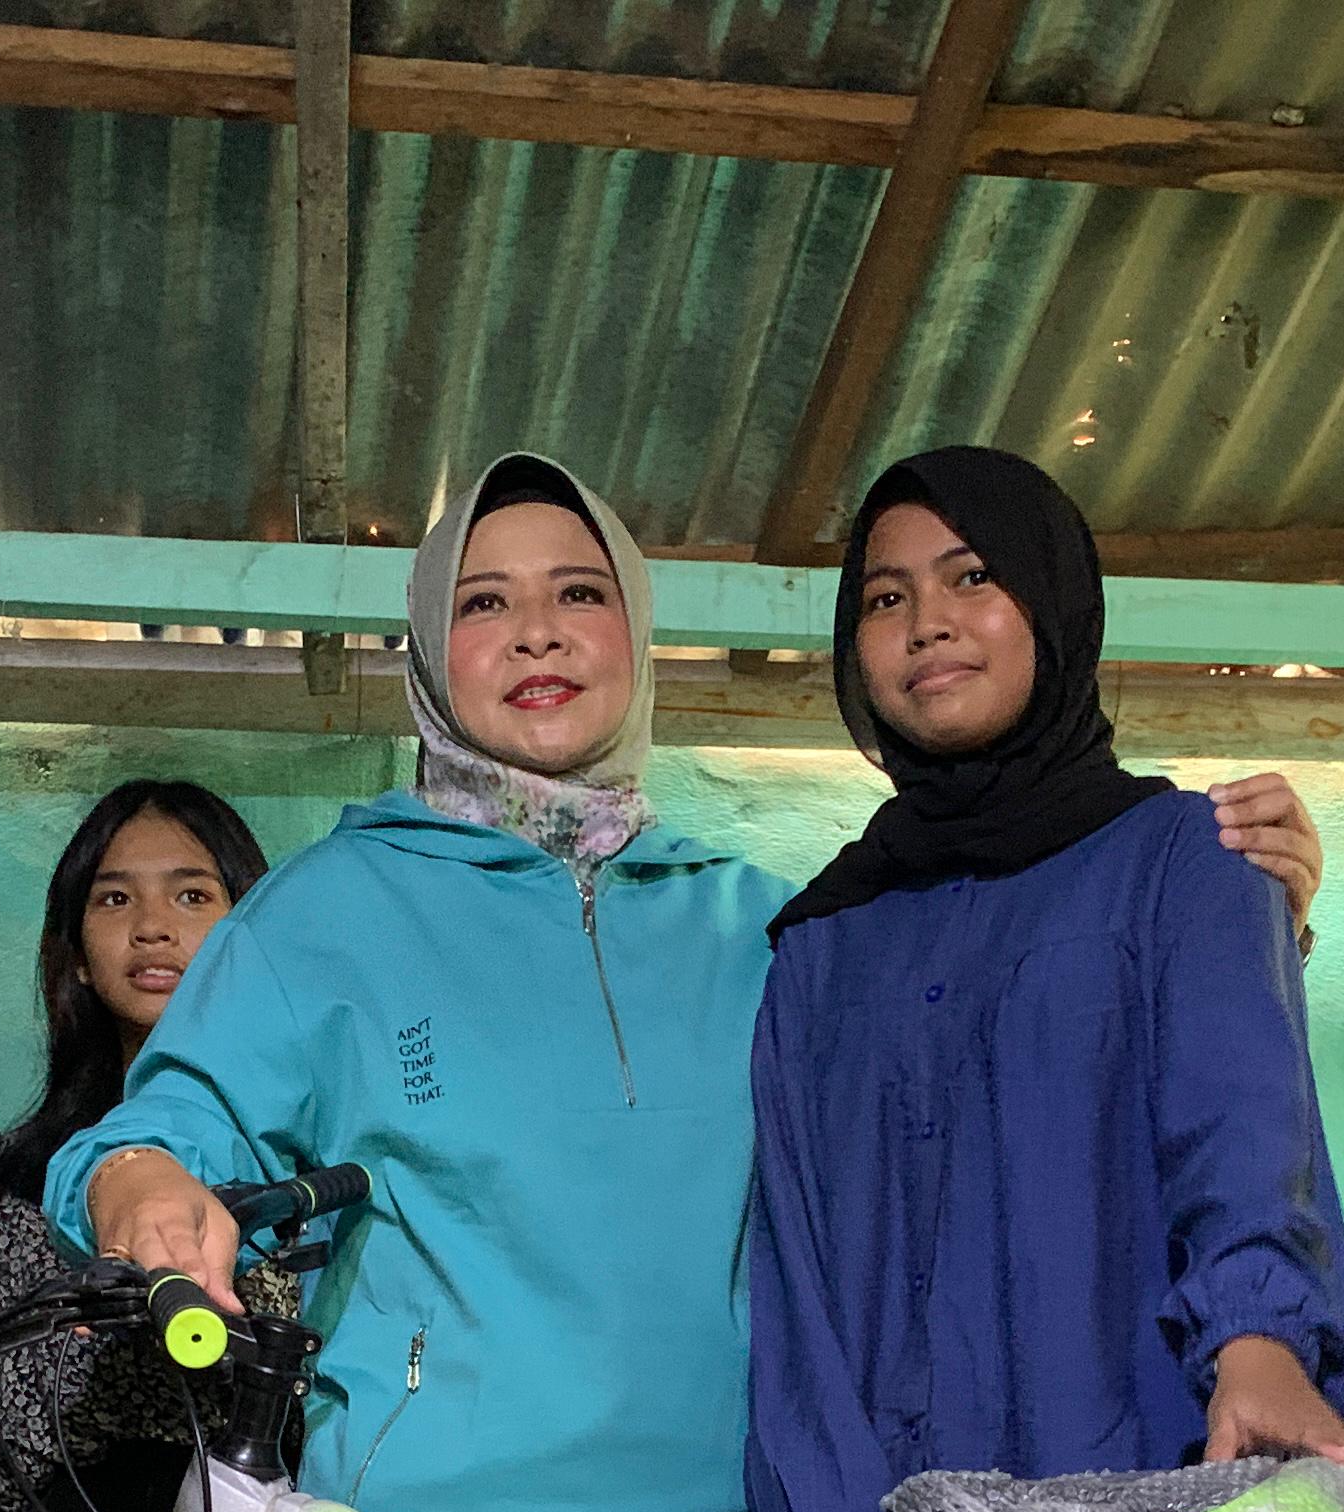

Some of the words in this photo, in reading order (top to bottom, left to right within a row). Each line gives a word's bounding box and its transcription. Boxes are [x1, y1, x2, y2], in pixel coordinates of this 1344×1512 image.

[398, 1036, 431, 1056] GOT
[400, 1052, 436, 1073] TIME
[403, 1071, 433, 1088] FOR
[404, 1084, 445, 1105] THAT.
